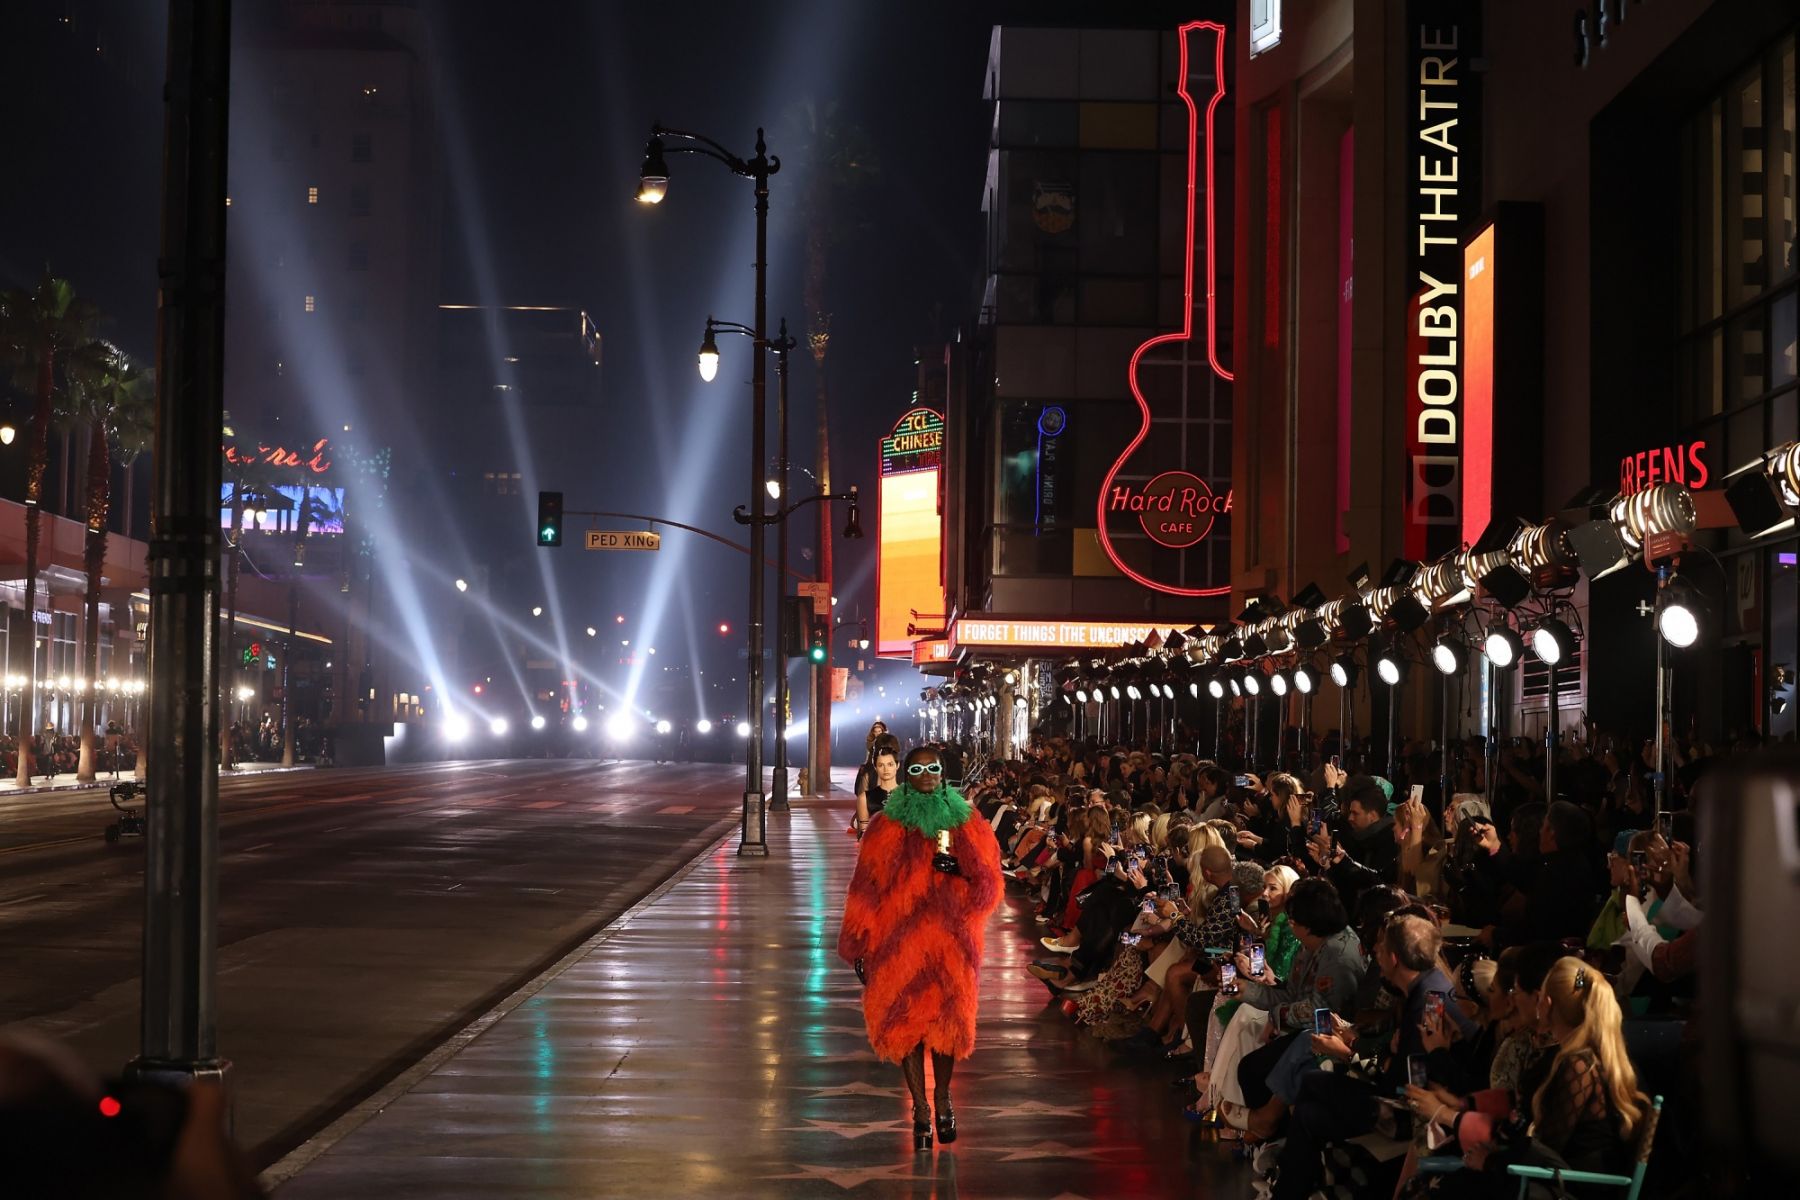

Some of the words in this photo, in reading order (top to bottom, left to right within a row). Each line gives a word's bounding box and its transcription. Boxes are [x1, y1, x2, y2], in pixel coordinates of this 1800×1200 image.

[1420, 24, 1458, 256] THEATRE
[1418, 271, 1458, 444] DOLBY
[907, 415, 928, 431] TCL
[893, 431, 943, 452] CHINESE
[1112, 486, 1175, 511] Hard
[1160, 522, 1193, 534] CAFE
[591, 535, 617, 546] PED
[624, 535, 654, 547] XING
[965, 624, 1009, 641] FORGET
[1013, 624, 1056, 642] THINGS
